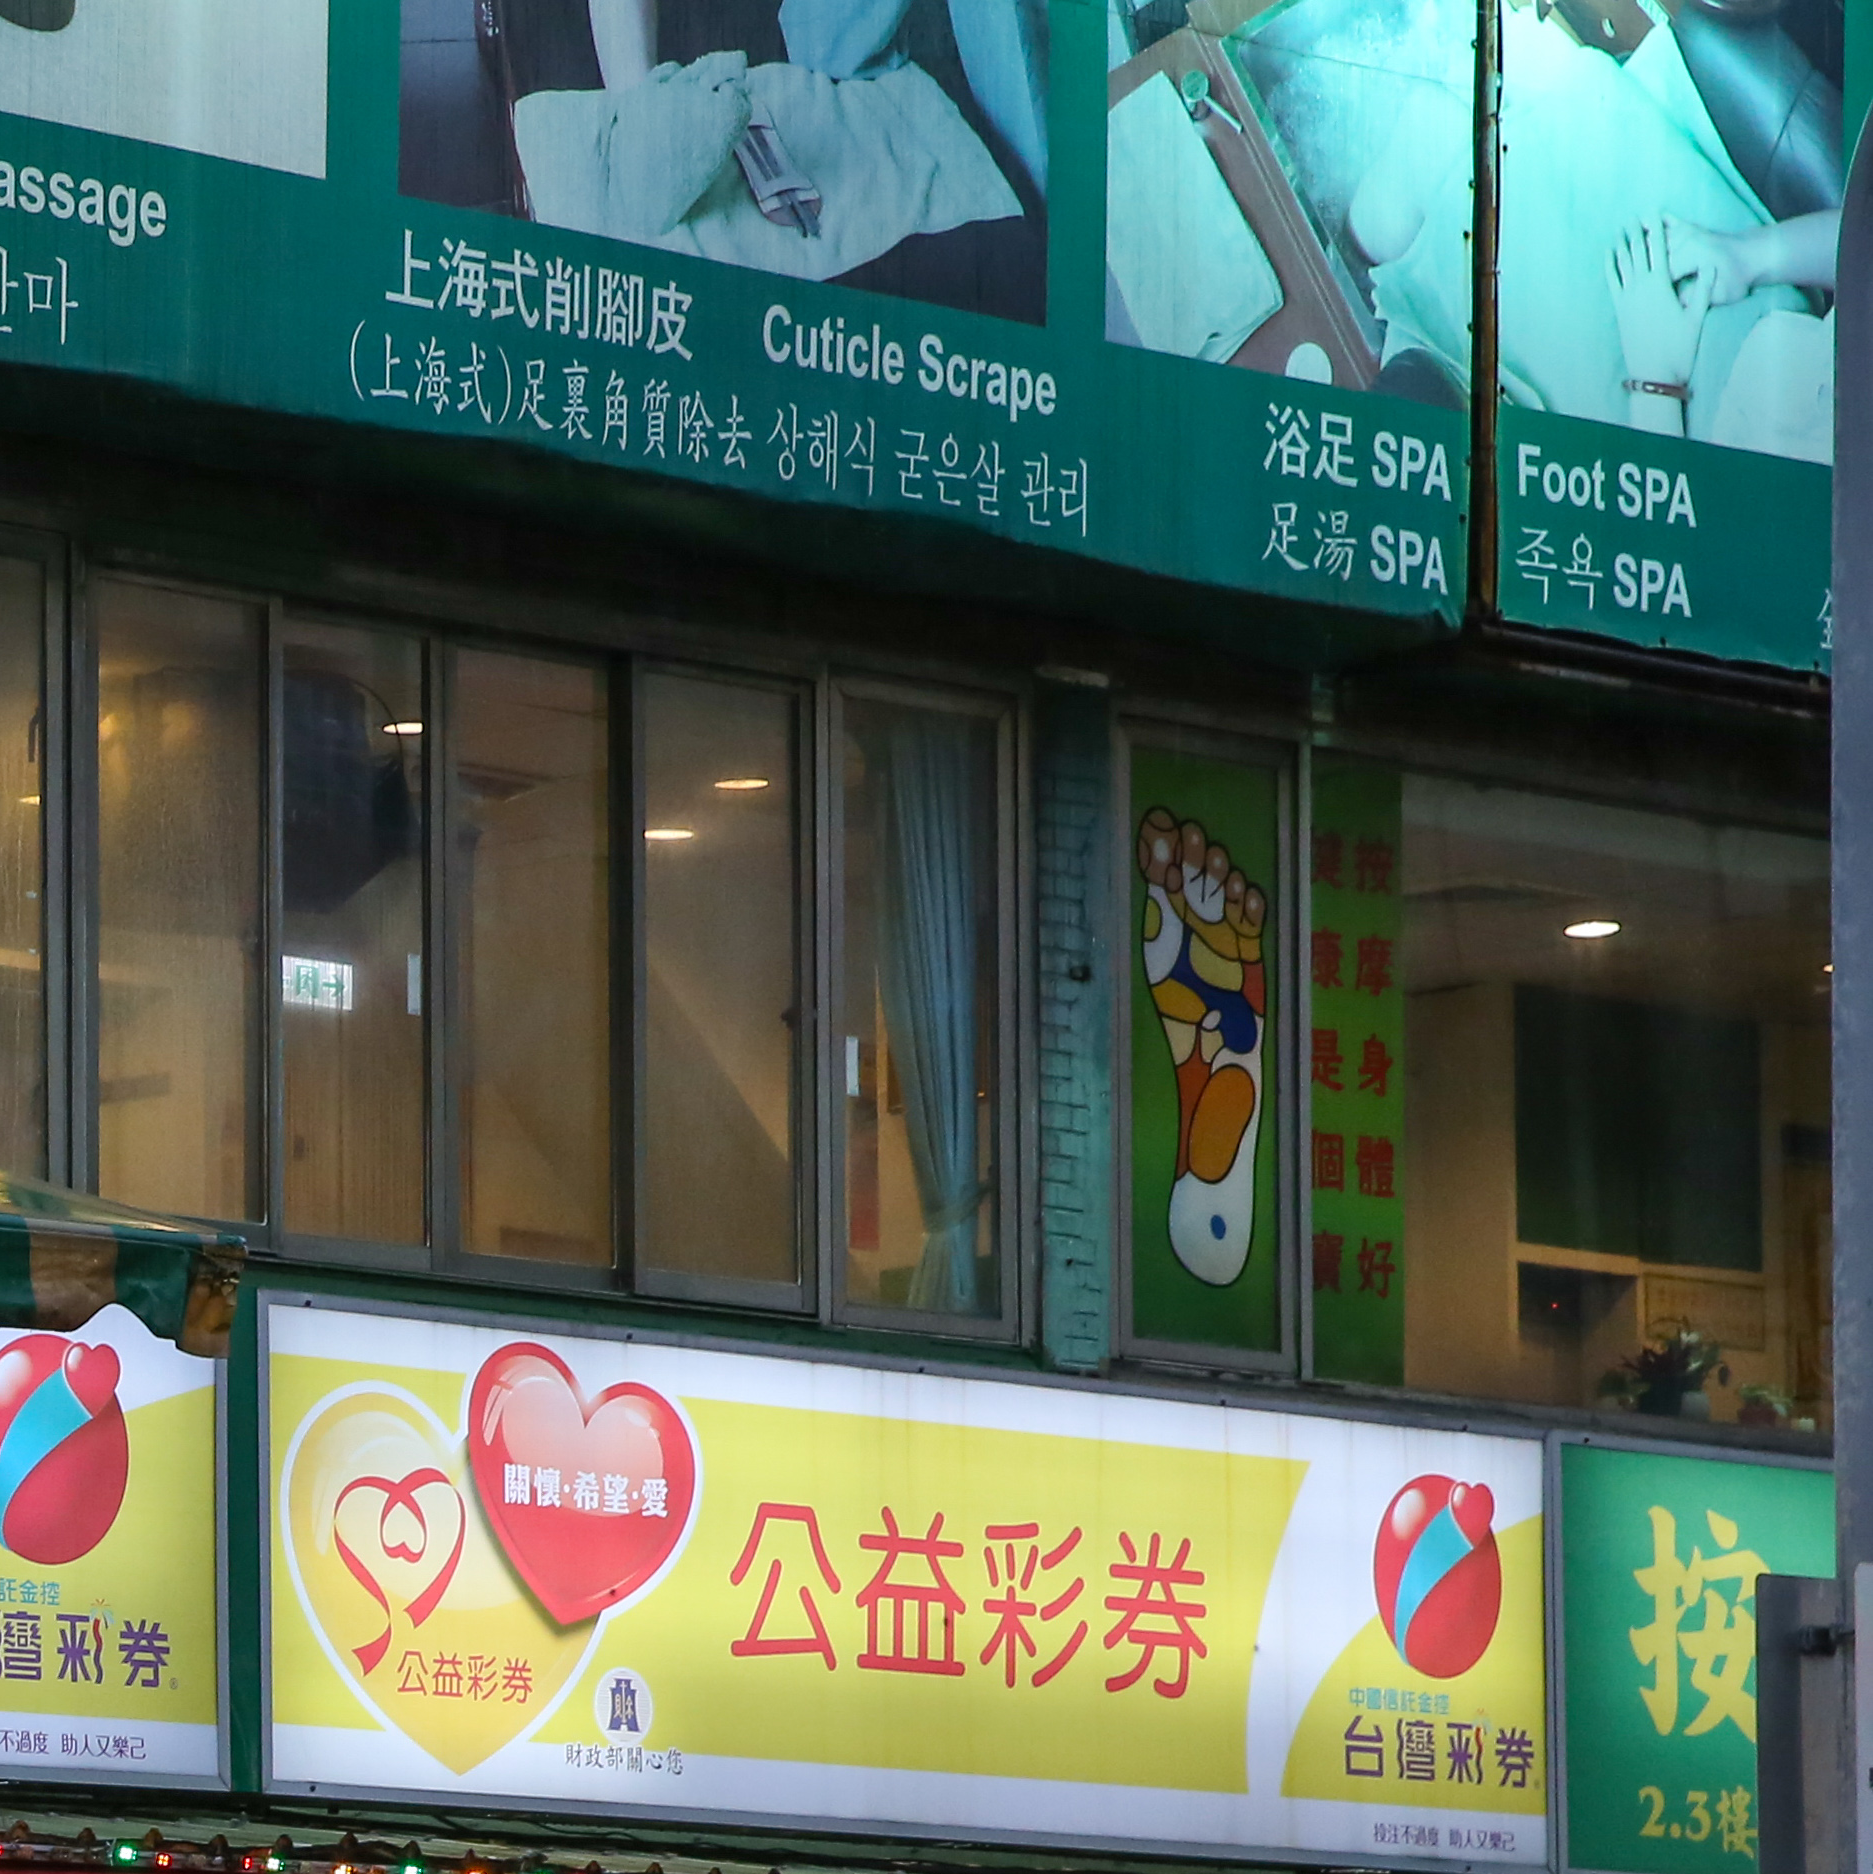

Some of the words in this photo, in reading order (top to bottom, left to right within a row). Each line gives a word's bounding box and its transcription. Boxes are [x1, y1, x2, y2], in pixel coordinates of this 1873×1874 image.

[384, 229, 694, 361] 上海式削腳皮
[761, 305, 906, 385] Cuticle
[917, 334, 1057, 423] Scrape
[766, 403, 877, 497] 상해식
[1019, 450, 1088, 537] 관리
[1262, 401, 1358, 489] 浴足
[1372, 430, 1452, 503] SPA
[1517, 442, 1606, 512] Foot
[1617, 462, 1697, 528] SPA
[1262, 501, 1357, 583] 足湯
[1370, 524, 1449, 596] SPA
[1515, 526, 1604, 611] 족욕
[1613, 553, 1692, 619] SPA
[729, 1500, 1208, 1700] 公益彩券
[396, 1650, 534, 1705] 公益彩券
[1349, 1686, 1450, 1714] 中國信託金控
[60, 1732, 147, 1762] 助人又樂己
[564, 1740, 684, 1775] 財政部關心您
[1343, 1711, 1535, 1791] 台灣彩券
